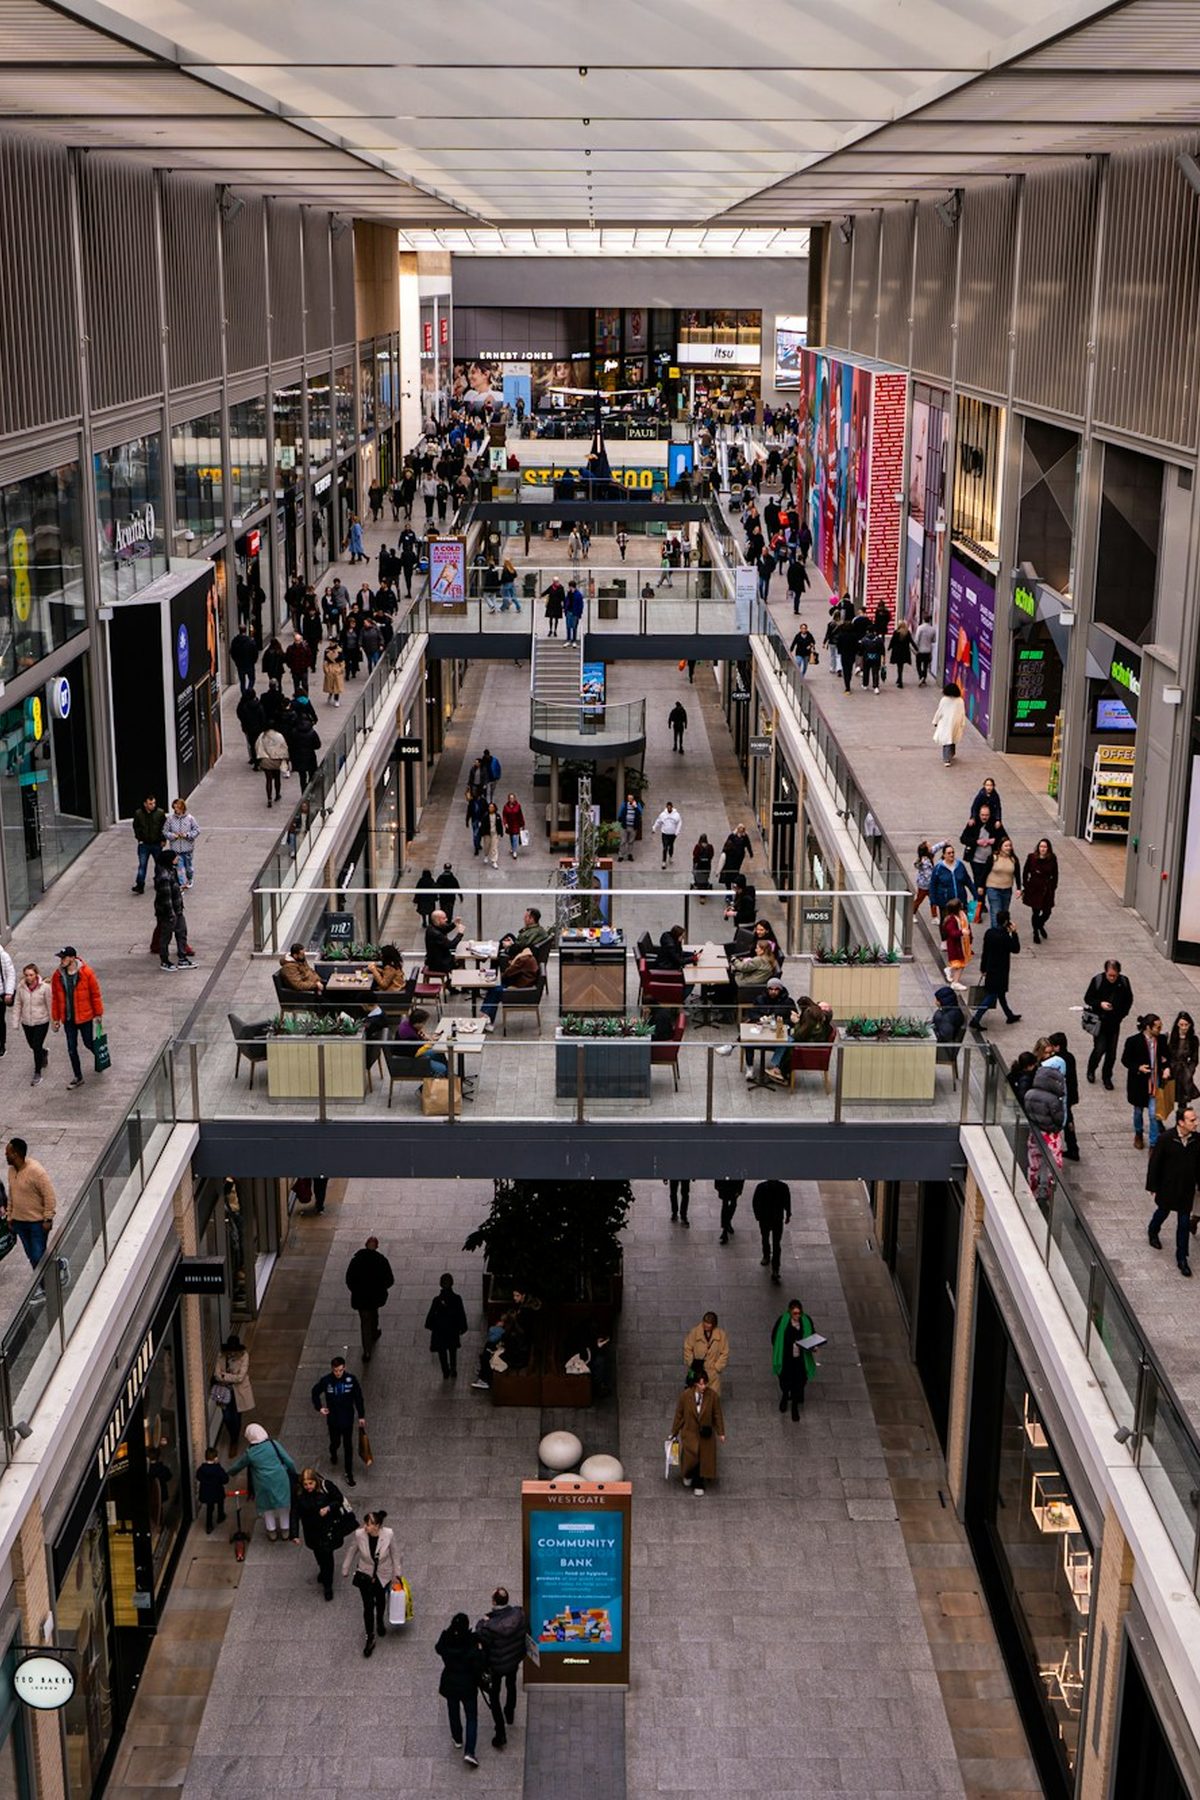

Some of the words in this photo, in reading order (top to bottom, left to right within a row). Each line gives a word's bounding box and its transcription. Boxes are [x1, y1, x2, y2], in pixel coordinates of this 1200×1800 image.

[480, 351, 518, 360] ERNEST
[521, 351, 554, 360] JONES
[714, 347, 734, 359] itsu
[629, 428, 656, 438] PAUL
[402, 746, 420, 754] BOSS
[806, 912, 829, 920] MOSS
[547, 1495, 606, 1504] WESTGATE
[537, 1538, 616, 1548] COMMUNITY
[560, 1558, 593, 1567] BANK
[15, 1676, 34, 1684] TED
[41, 1676, 72, 1684] BAKER
